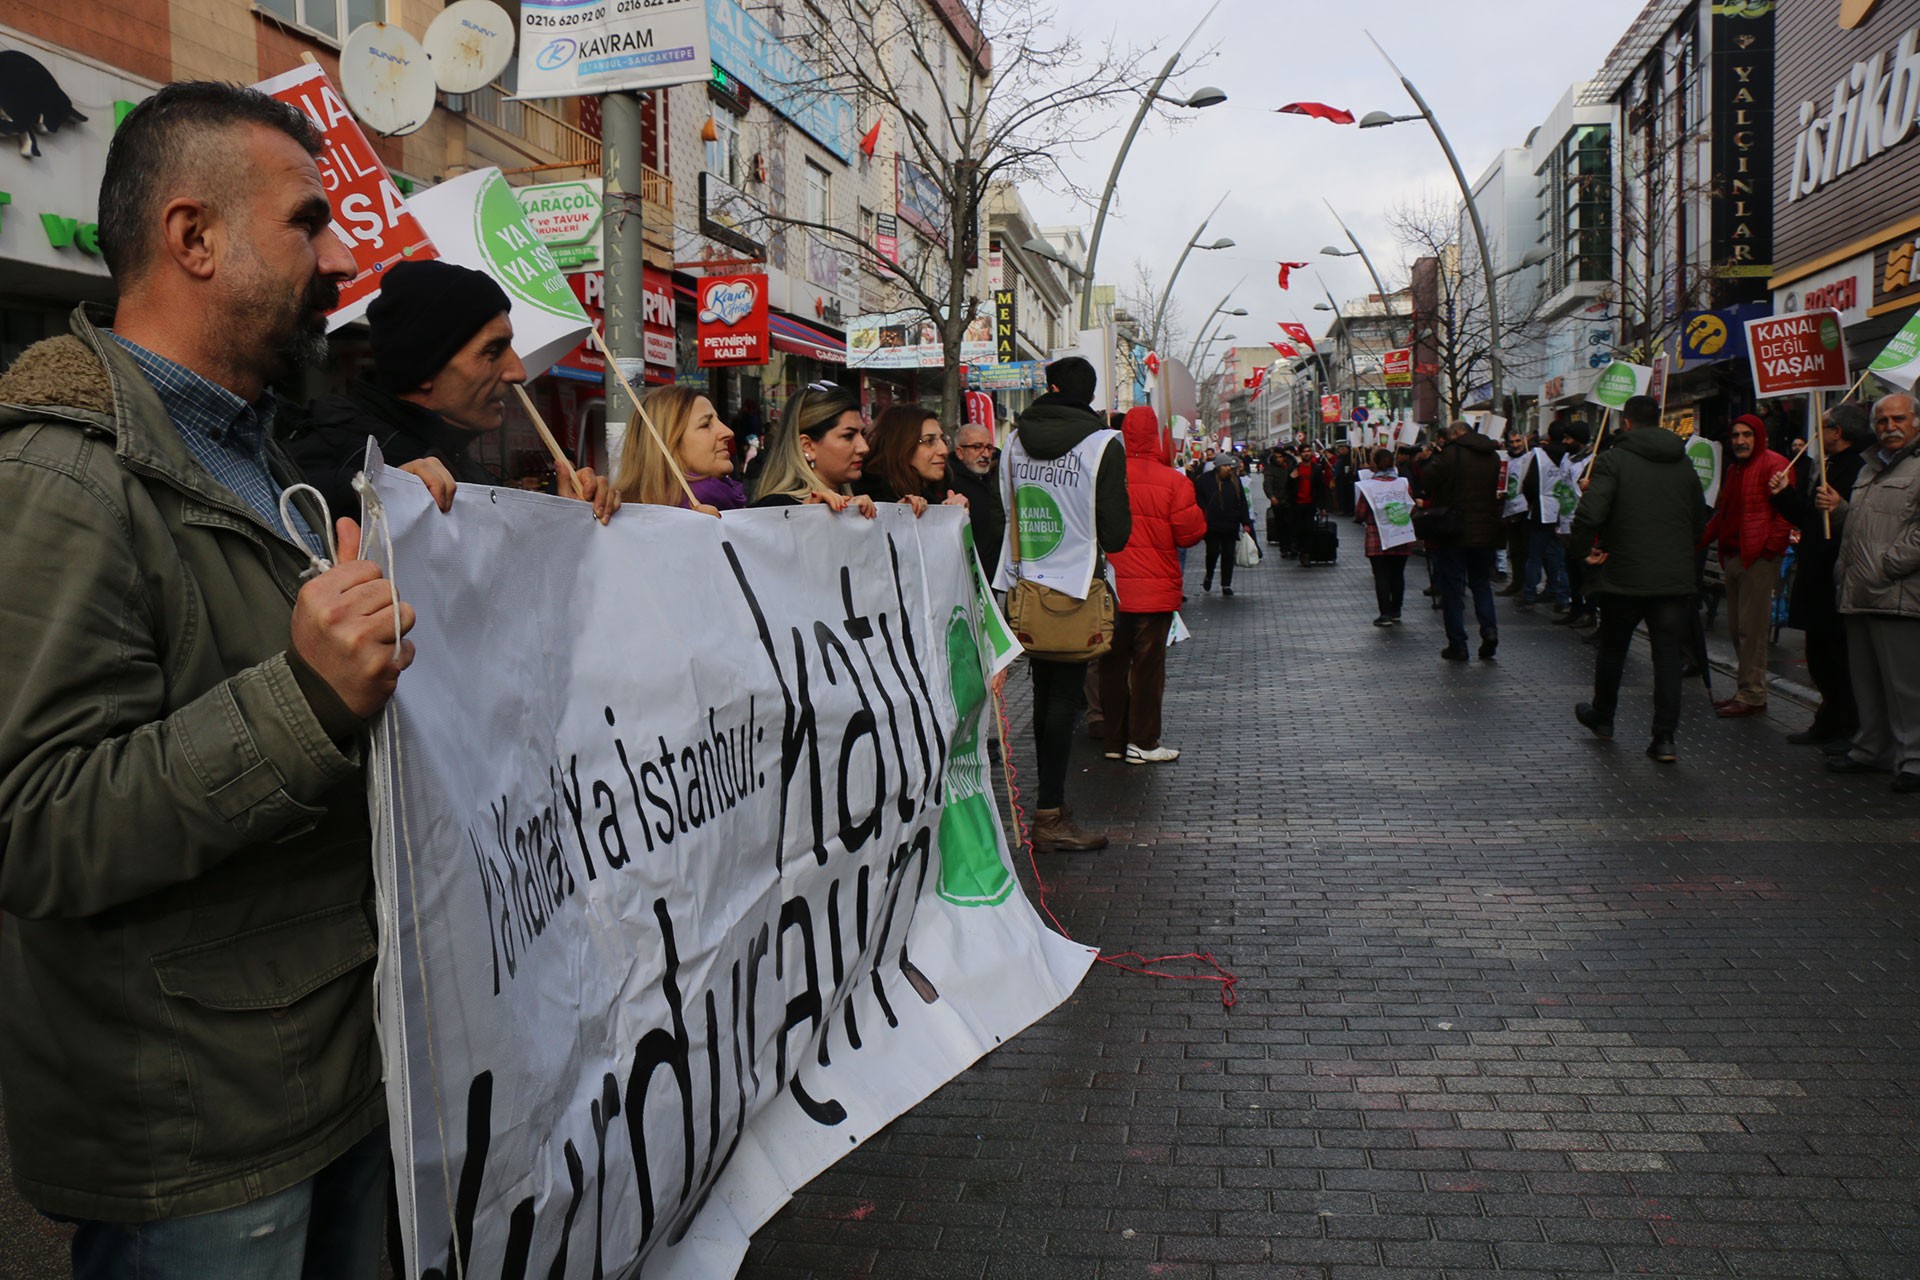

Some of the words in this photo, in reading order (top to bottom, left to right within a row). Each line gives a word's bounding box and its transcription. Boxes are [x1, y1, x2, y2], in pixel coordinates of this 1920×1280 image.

[526, 14, 556, 27] 0216
[559, 14, 579, 26] 620
[581, 12, 593, 23] 92
[595, 7, 606, 20] 00
[617, 0, 641, 13] 0216
[460, 19, 497, 38] SUNNY
[578, 28, 654, 59] KAVRAM
[368, 46, 411, 67] SUNNY
[1732, 66, 1756, 261] YALÇINLAR
[521, 193, 595, 215] KARAÇÖL
[553, 213, 590, 225] TAVUK
[496, 223, 531, 252] YA
[503, 256, 540, 286] YA
[712, 286, 746, 311] Kaya
[704, 333, 757, 347] PEYNİR'İN
[1757, 318, 1817, 342] KANAL
[714, 346, 747, 359] KALBİ
[1760, 337, 1809, 359] DEĞİL
[1762, 353, 1825, 378] YAŞAM
[1020, 507, 1052, 519] KANAL
[1019, 521, 1061, 533] STANBUL
[557, 753, 631, 881] Ya
